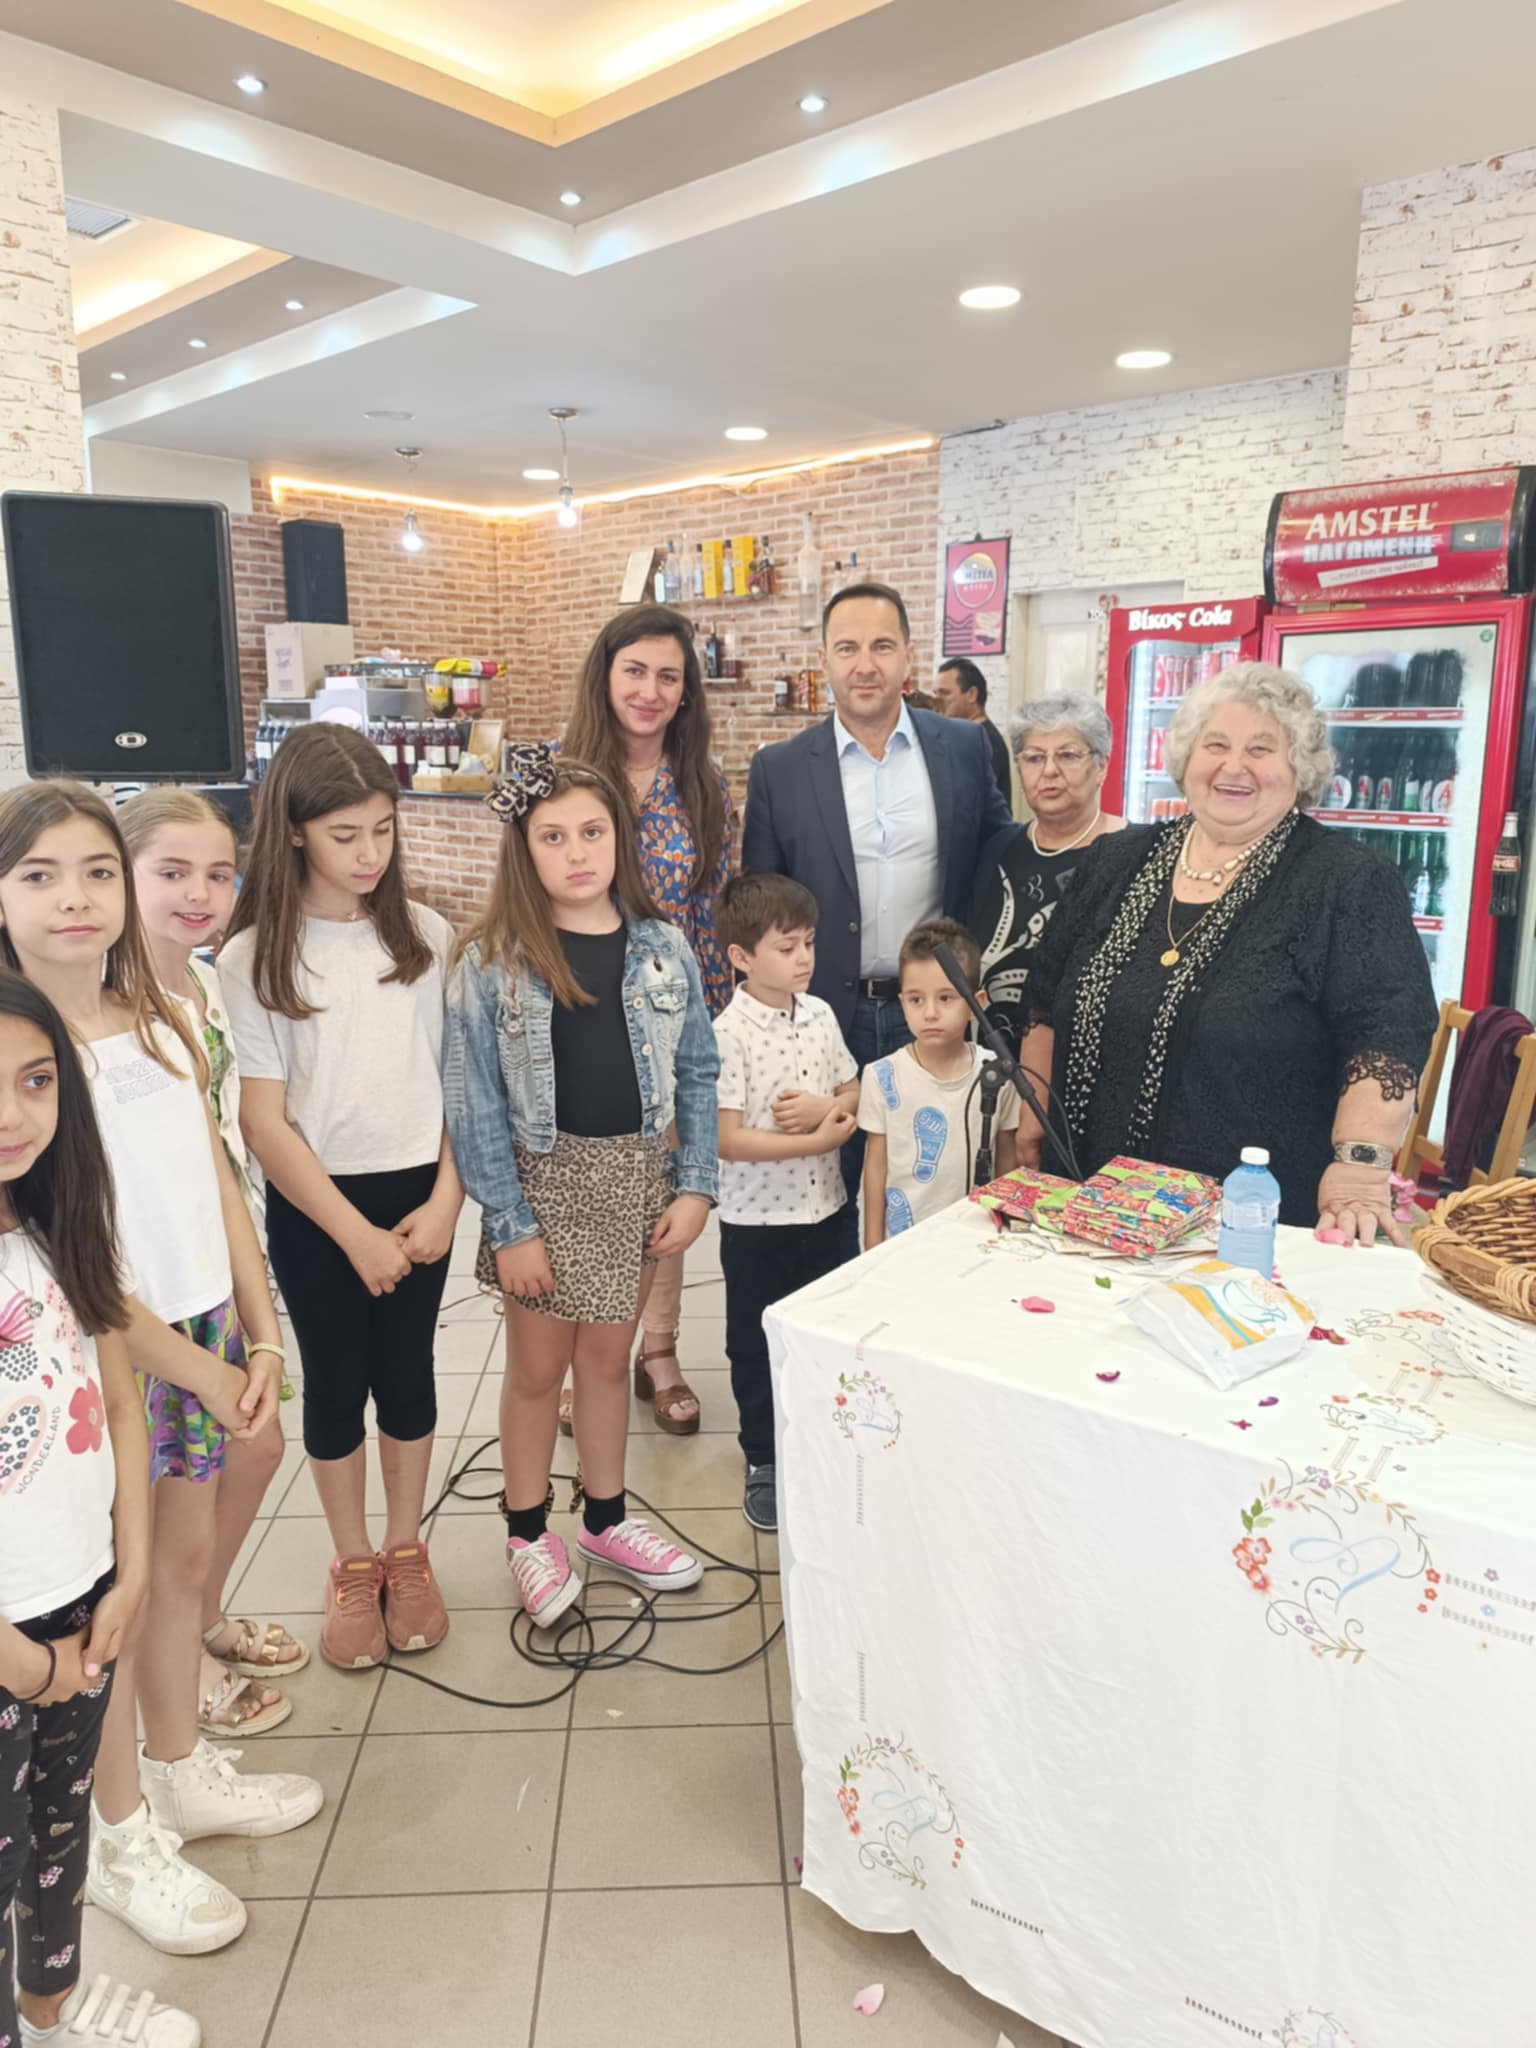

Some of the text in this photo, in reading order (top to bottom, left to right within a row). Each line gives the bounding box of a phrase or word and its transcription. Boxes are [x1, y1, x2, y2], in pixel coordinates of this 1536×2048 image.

[1304, 503, 1436, 541] AMSTEL
[1189, 604, 1233, 627] Cola
[16, 1406, 61, 1495] WONDERLAND
